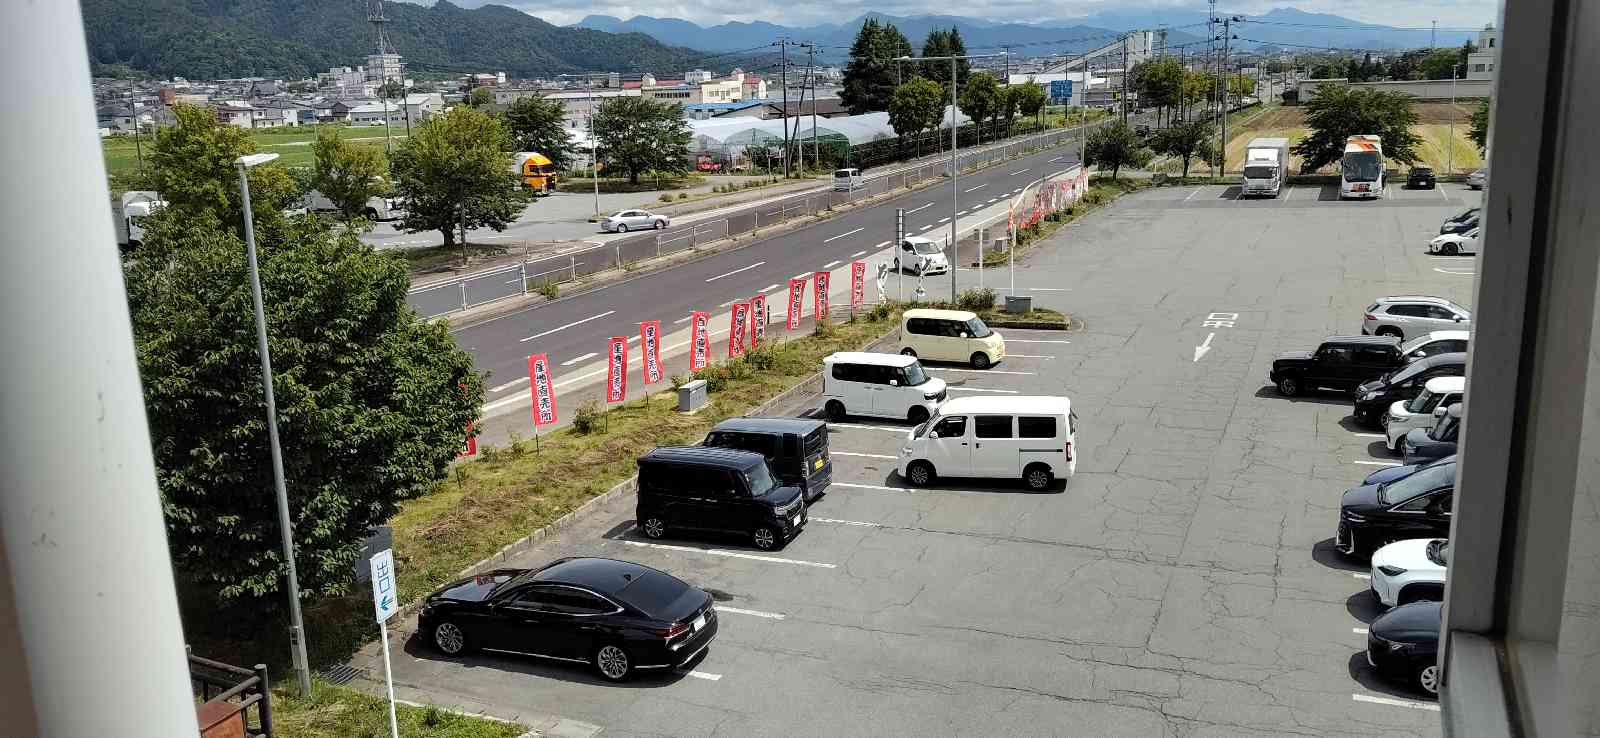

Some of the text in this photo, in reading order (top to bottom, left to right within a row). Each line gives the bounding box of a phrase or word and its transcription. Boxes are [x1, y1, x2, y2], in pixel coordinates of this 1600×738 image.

[534, 359, 552, 422] 産地直売所
[377, 560, 390, 593] 出口
